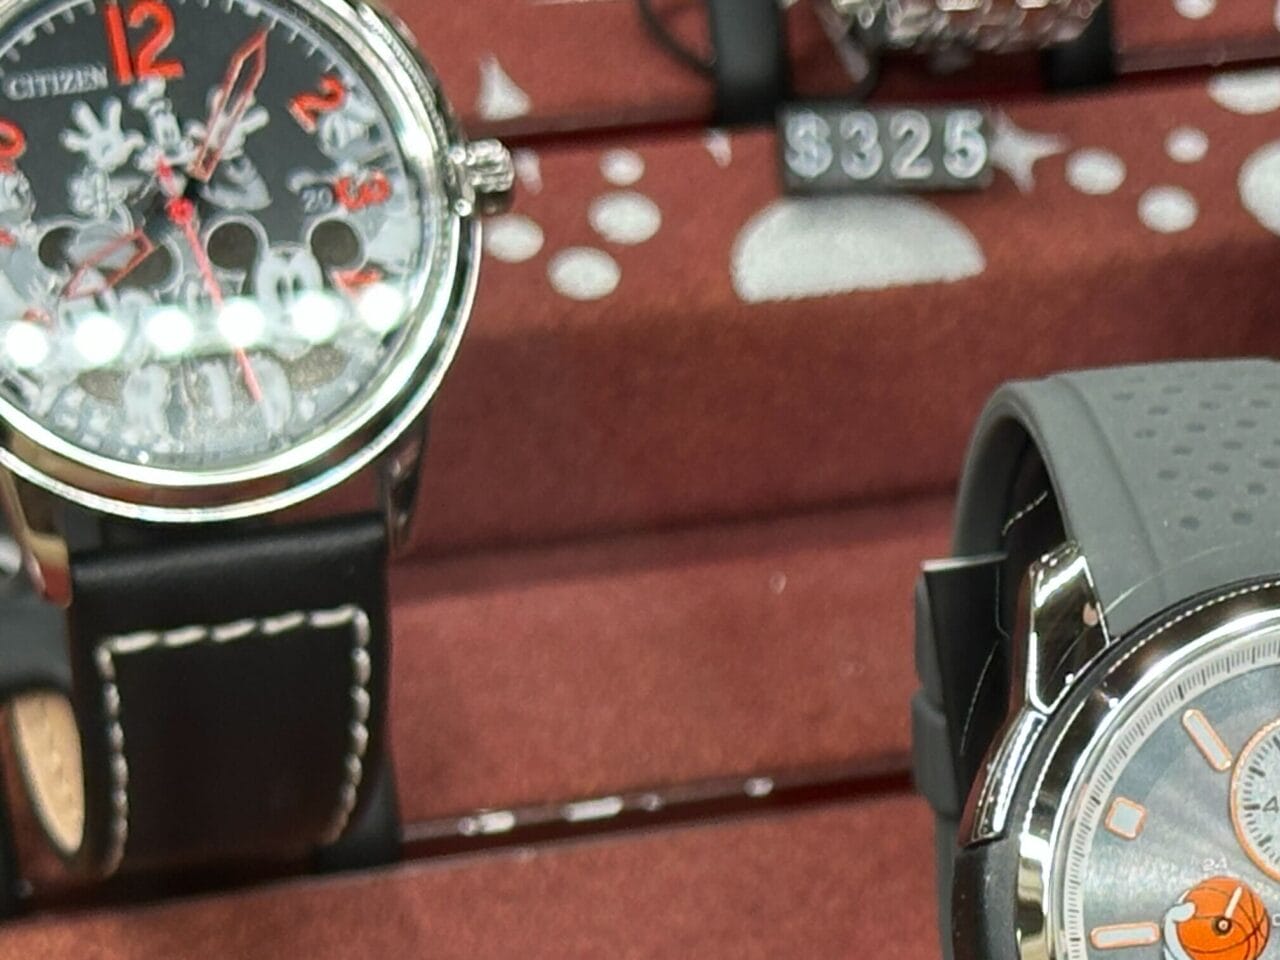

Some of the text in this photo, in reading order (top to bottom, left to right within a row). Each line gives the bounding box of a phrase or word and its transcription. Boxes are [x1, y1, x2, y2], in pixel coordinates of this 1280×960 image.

[104, 0, 184, 86] 12
[5, 65, 109, 100] CITIZEN
[288, 75, 346, 133] 2
